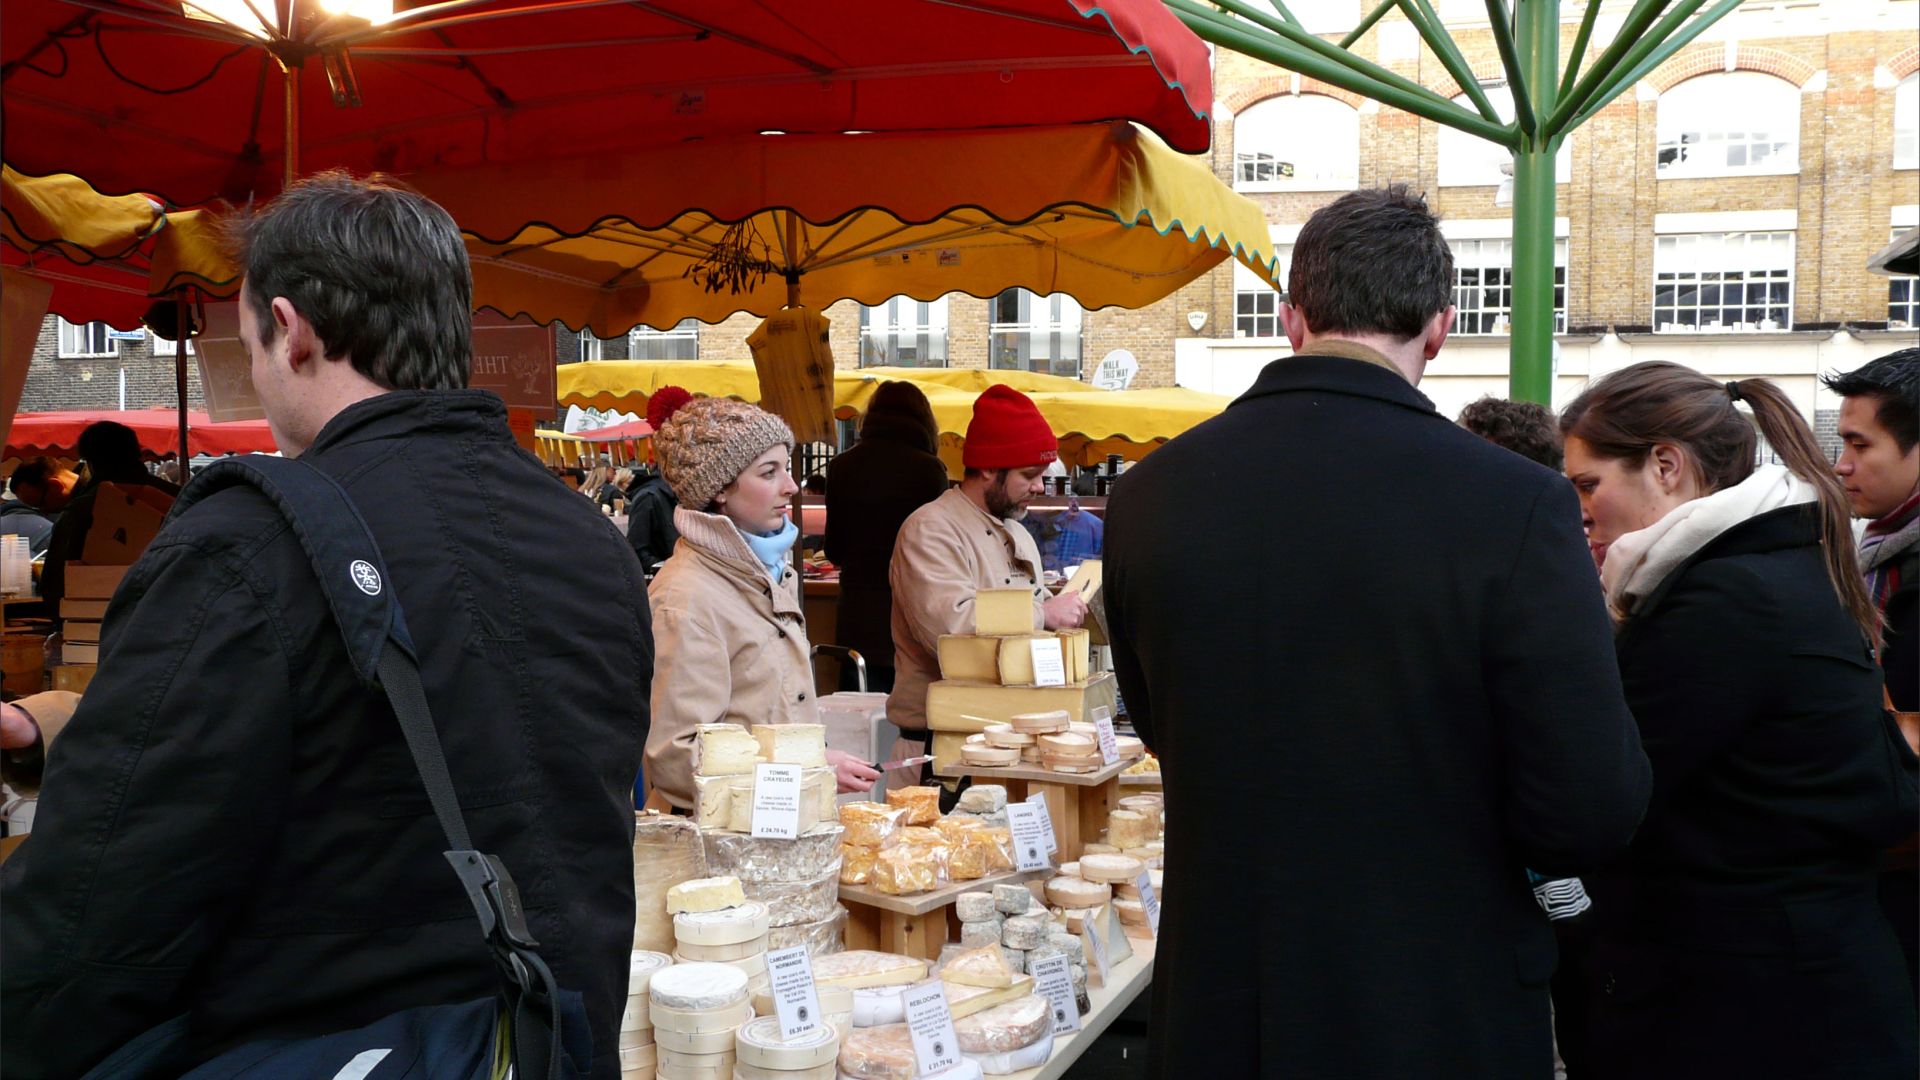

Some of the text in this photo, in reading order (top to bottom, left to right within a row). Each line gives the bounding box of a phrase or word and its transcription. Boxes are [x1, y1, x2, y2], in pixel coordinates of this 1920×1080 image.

[1103, 359, 1119, 368] WALK
[1104, 368, 1128, 379] THIS WAY
[769, 952, 798, 963] CAMEMBERT
[776, 959, 802, 969] NORMANDIE
[1036, 962, 1056, 970] CROTTIN
[910, 993, 941, 1007] REBLOCHON
[803, 1023, 814, 1031] each
